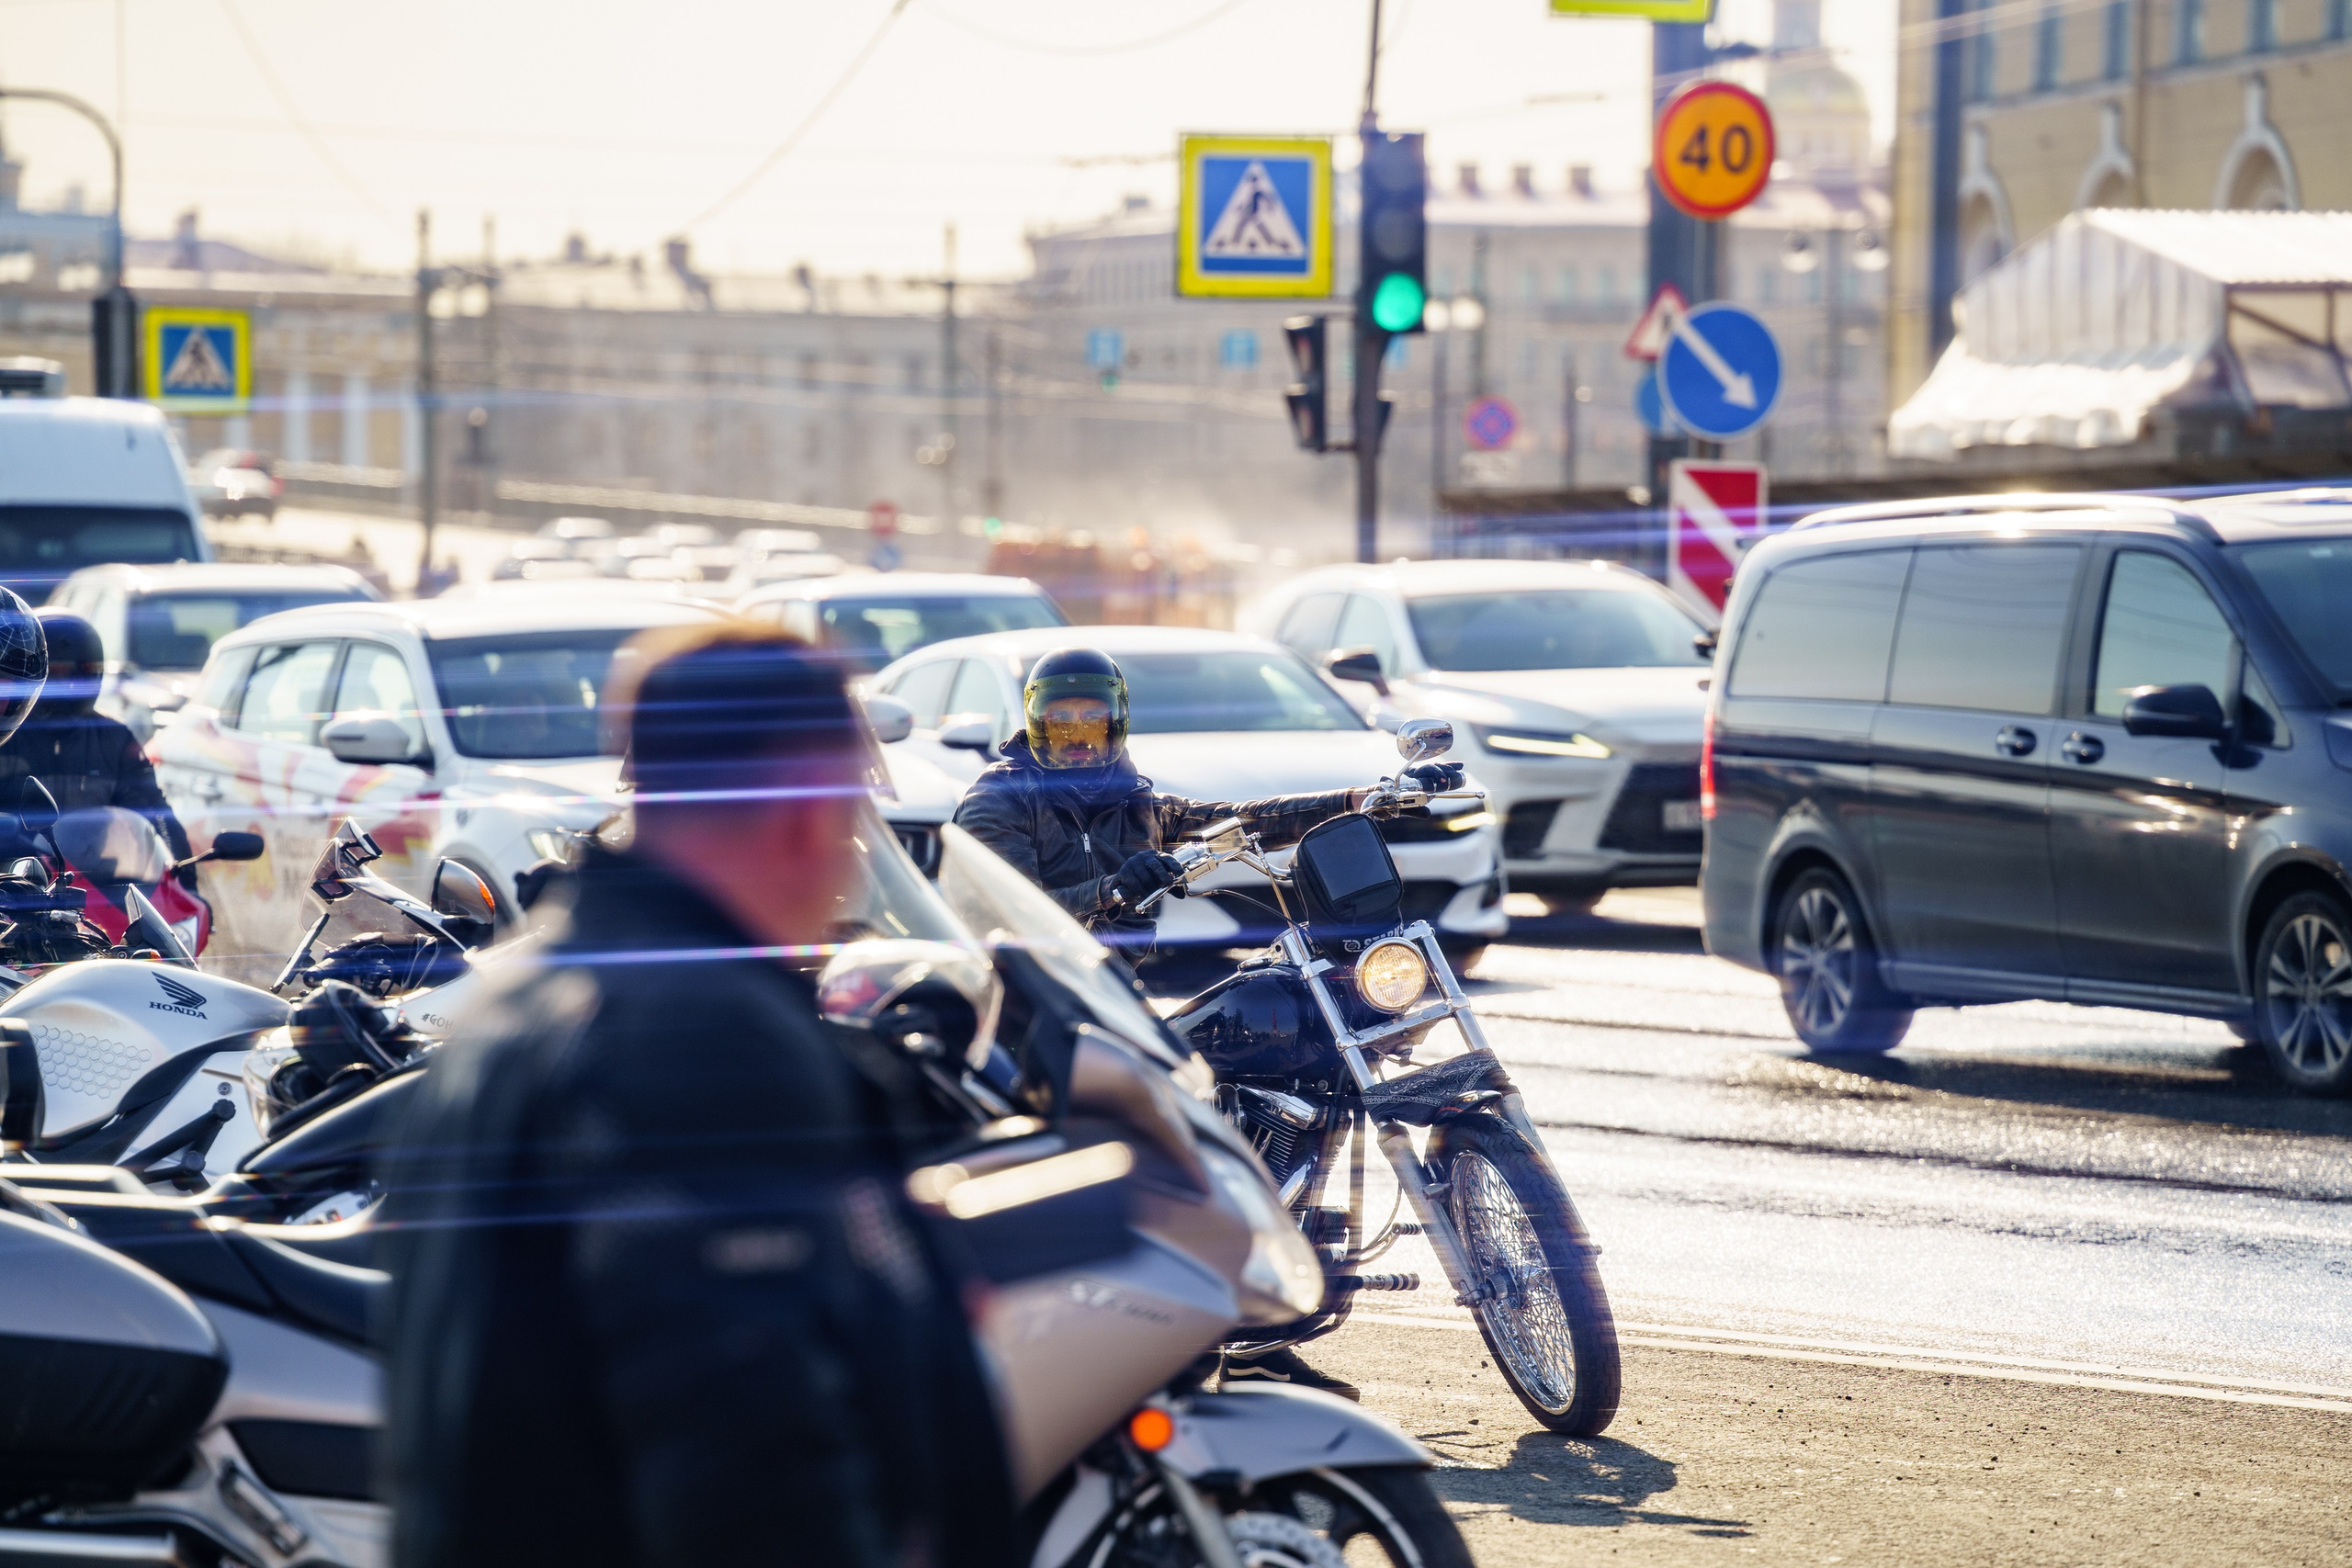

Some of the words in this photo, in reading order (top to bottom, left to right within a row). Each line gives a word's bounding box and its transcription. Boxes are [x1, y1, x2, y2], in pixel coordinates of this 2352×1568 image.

[1679, 123, 1753, 174] 40
[149, 1001, 208, 1020] HONDA
[422, 1013, 457, 1030] #GOH
